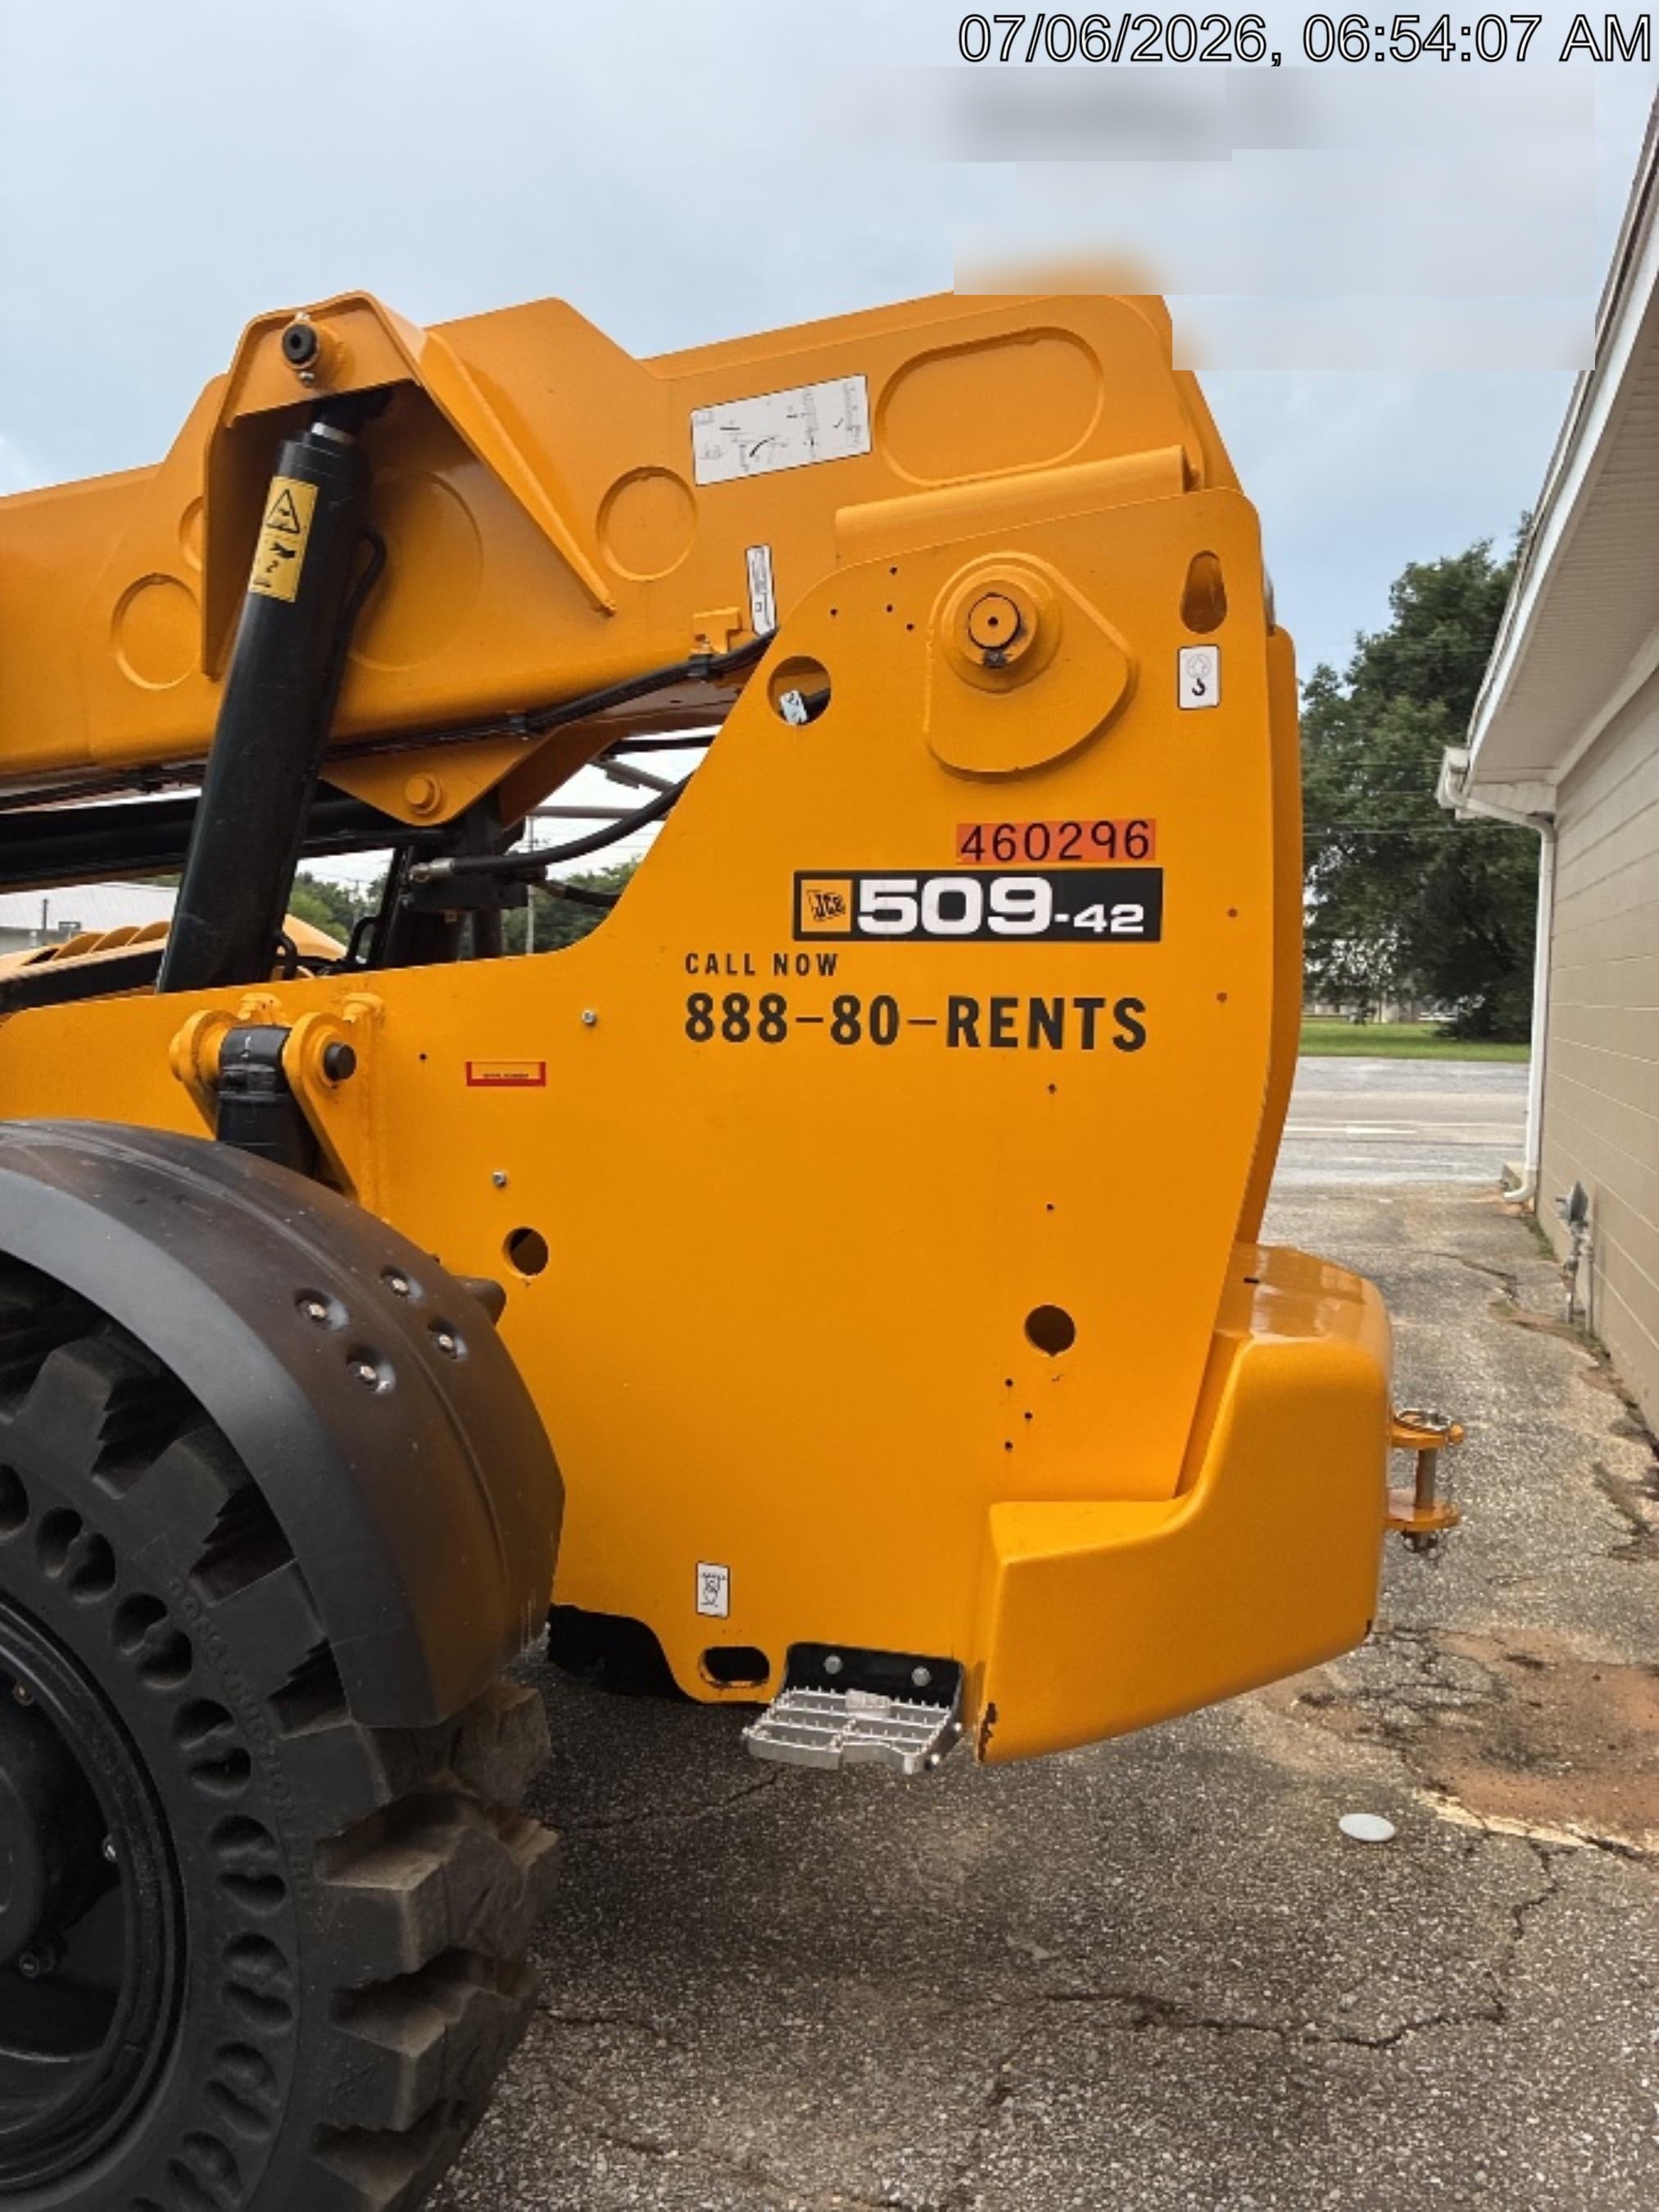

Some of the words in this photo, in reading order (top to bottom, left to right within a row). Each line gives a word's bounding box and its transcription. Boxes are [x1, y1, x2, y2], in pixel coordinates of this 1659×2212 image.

[960, 820, 1150, 862] 460296
[806, 890, 846, 922] JCB
[858, 877, 1145, 936] 509-42
[685, 953, 756, 976] CALL
[773, 954, 839, 977] NOW
[685, 992, 1147, 1053] 888-80-RENTS
